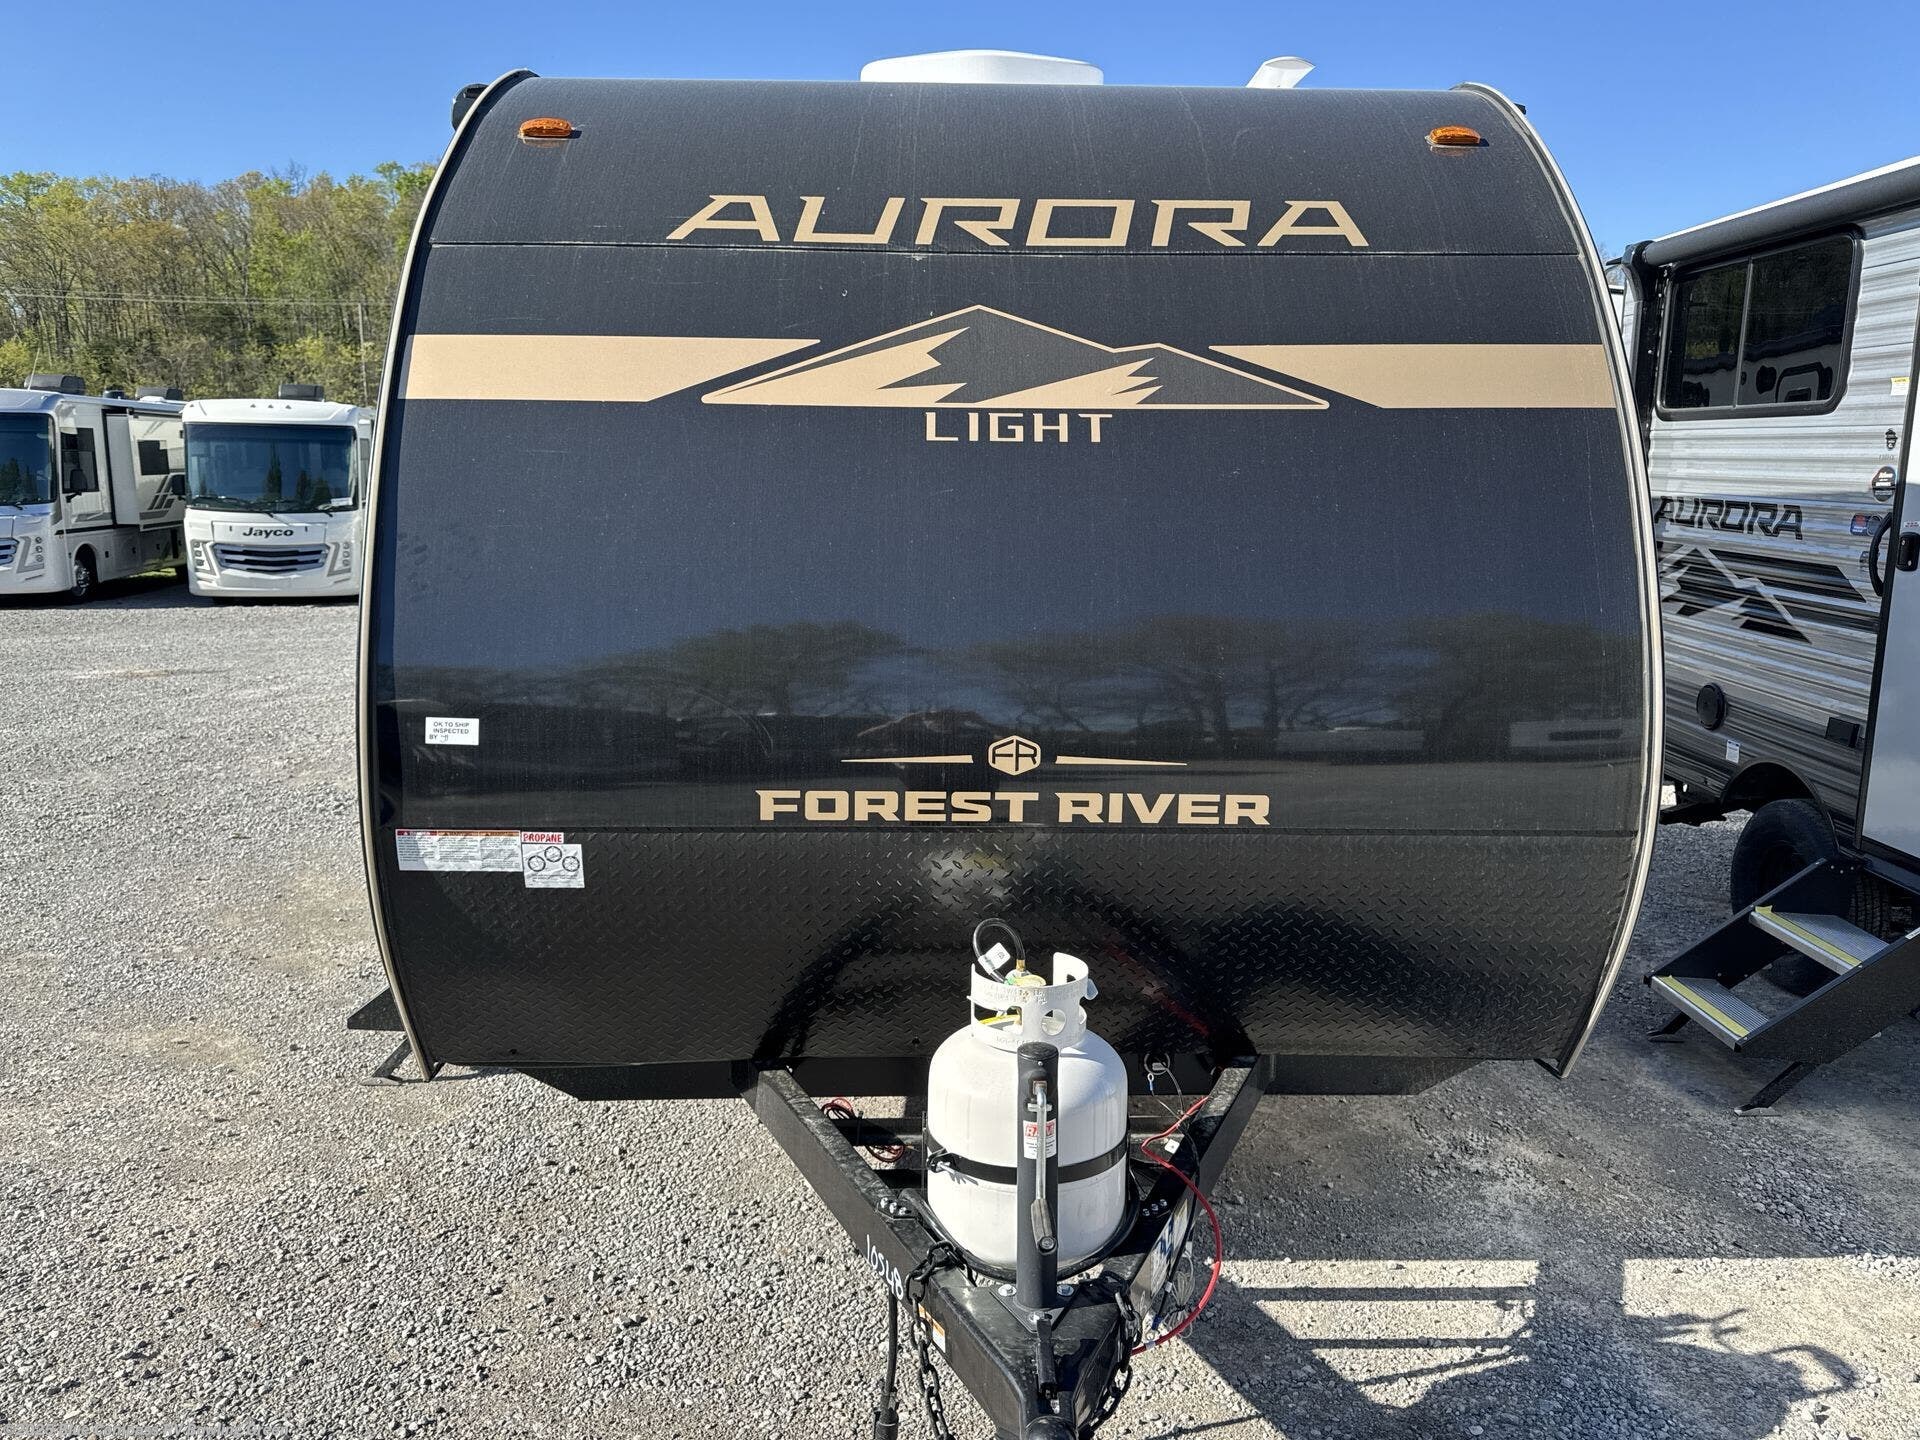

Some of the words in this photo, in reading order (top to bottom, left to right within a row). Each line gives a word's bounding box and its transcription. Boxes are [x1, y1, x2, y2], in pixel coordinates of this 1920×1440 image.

[665, 194, 1369, 247] AURORA
[925, 411, 1113, 443] LIGHT
[242, 526, 294, 539] Jayco
[1654, 496, 1803, 541] AURORA
[755, 789, 1039, 823] FOREST
[1054, 792, 1271, 825] RIVER
[523, 833, 563, 843] PROPANE
